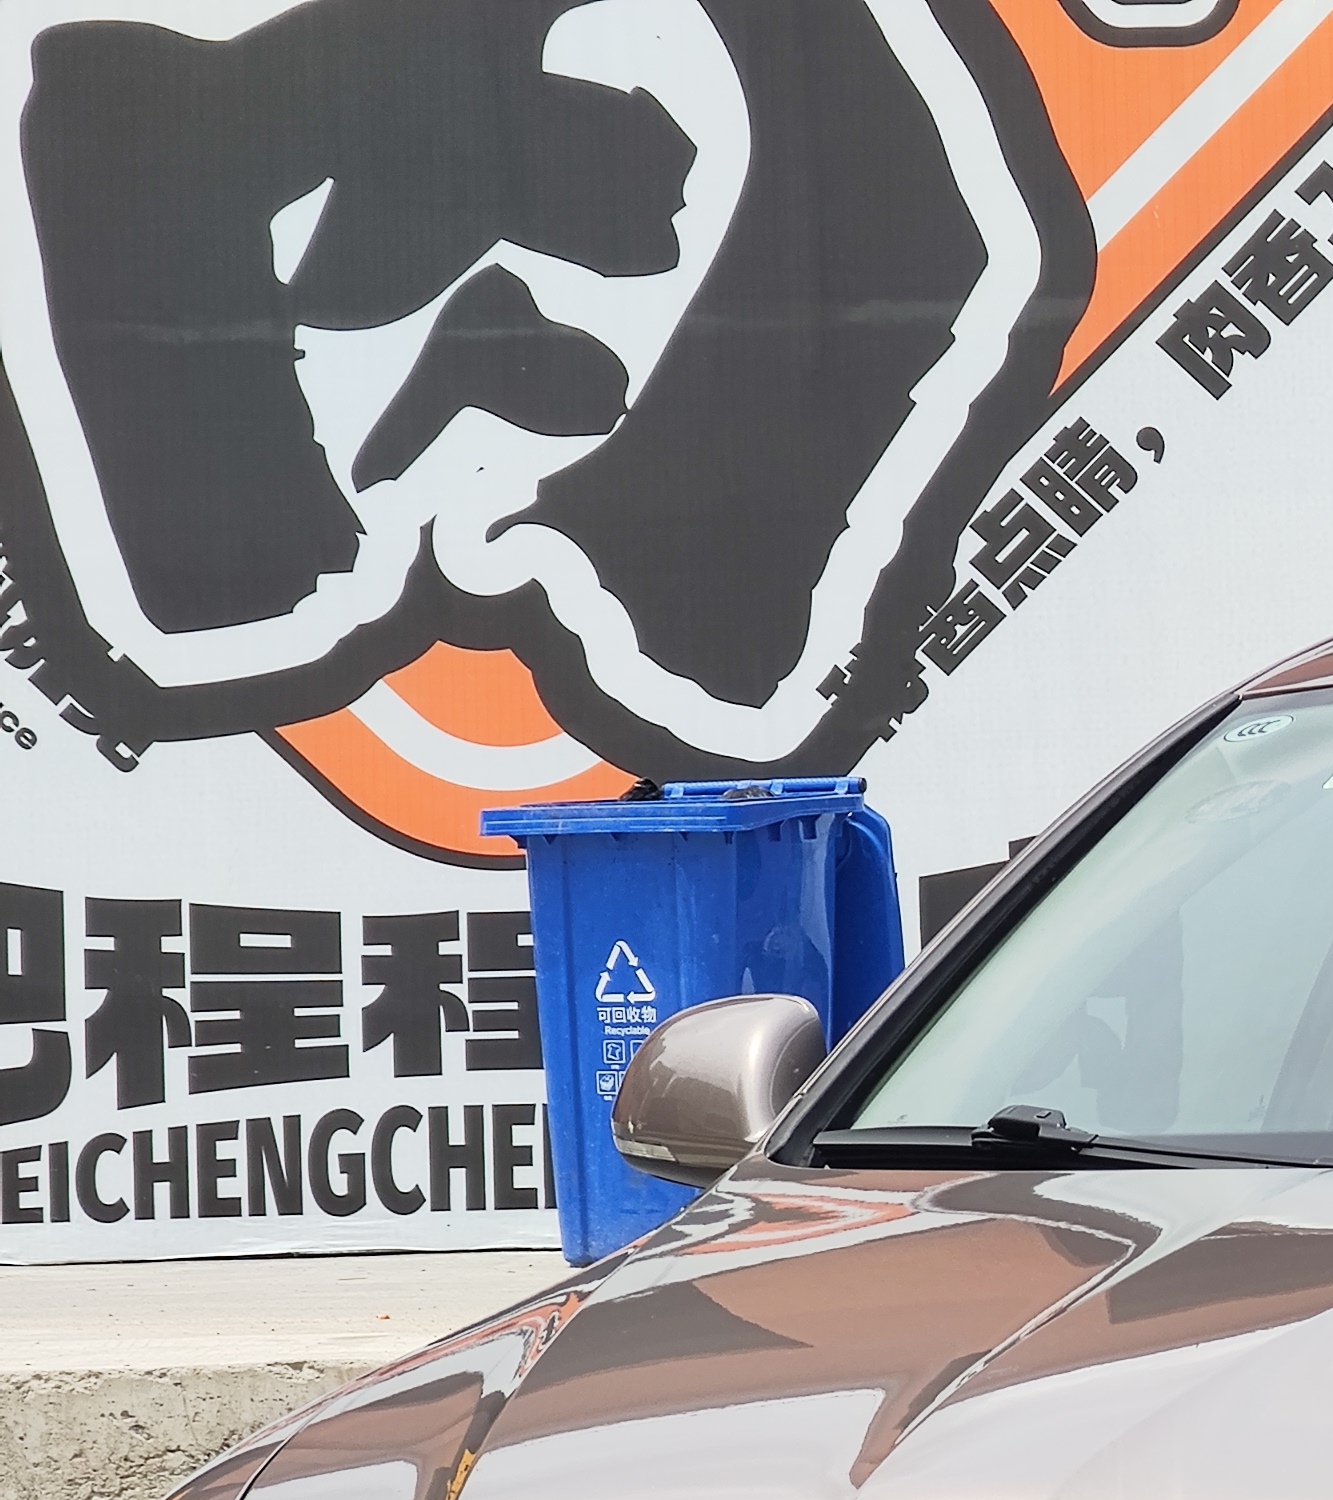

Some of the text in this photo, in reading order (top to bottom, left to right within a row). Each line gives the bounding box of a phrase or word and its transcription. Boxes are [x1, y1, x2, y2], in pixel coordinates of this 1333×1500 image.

[596, 1005, 657, 1023] 可回收物
[604, 1025, 651, 1037] Recyclable
[0, 1103, 557, 1224] EICHENGCHE
